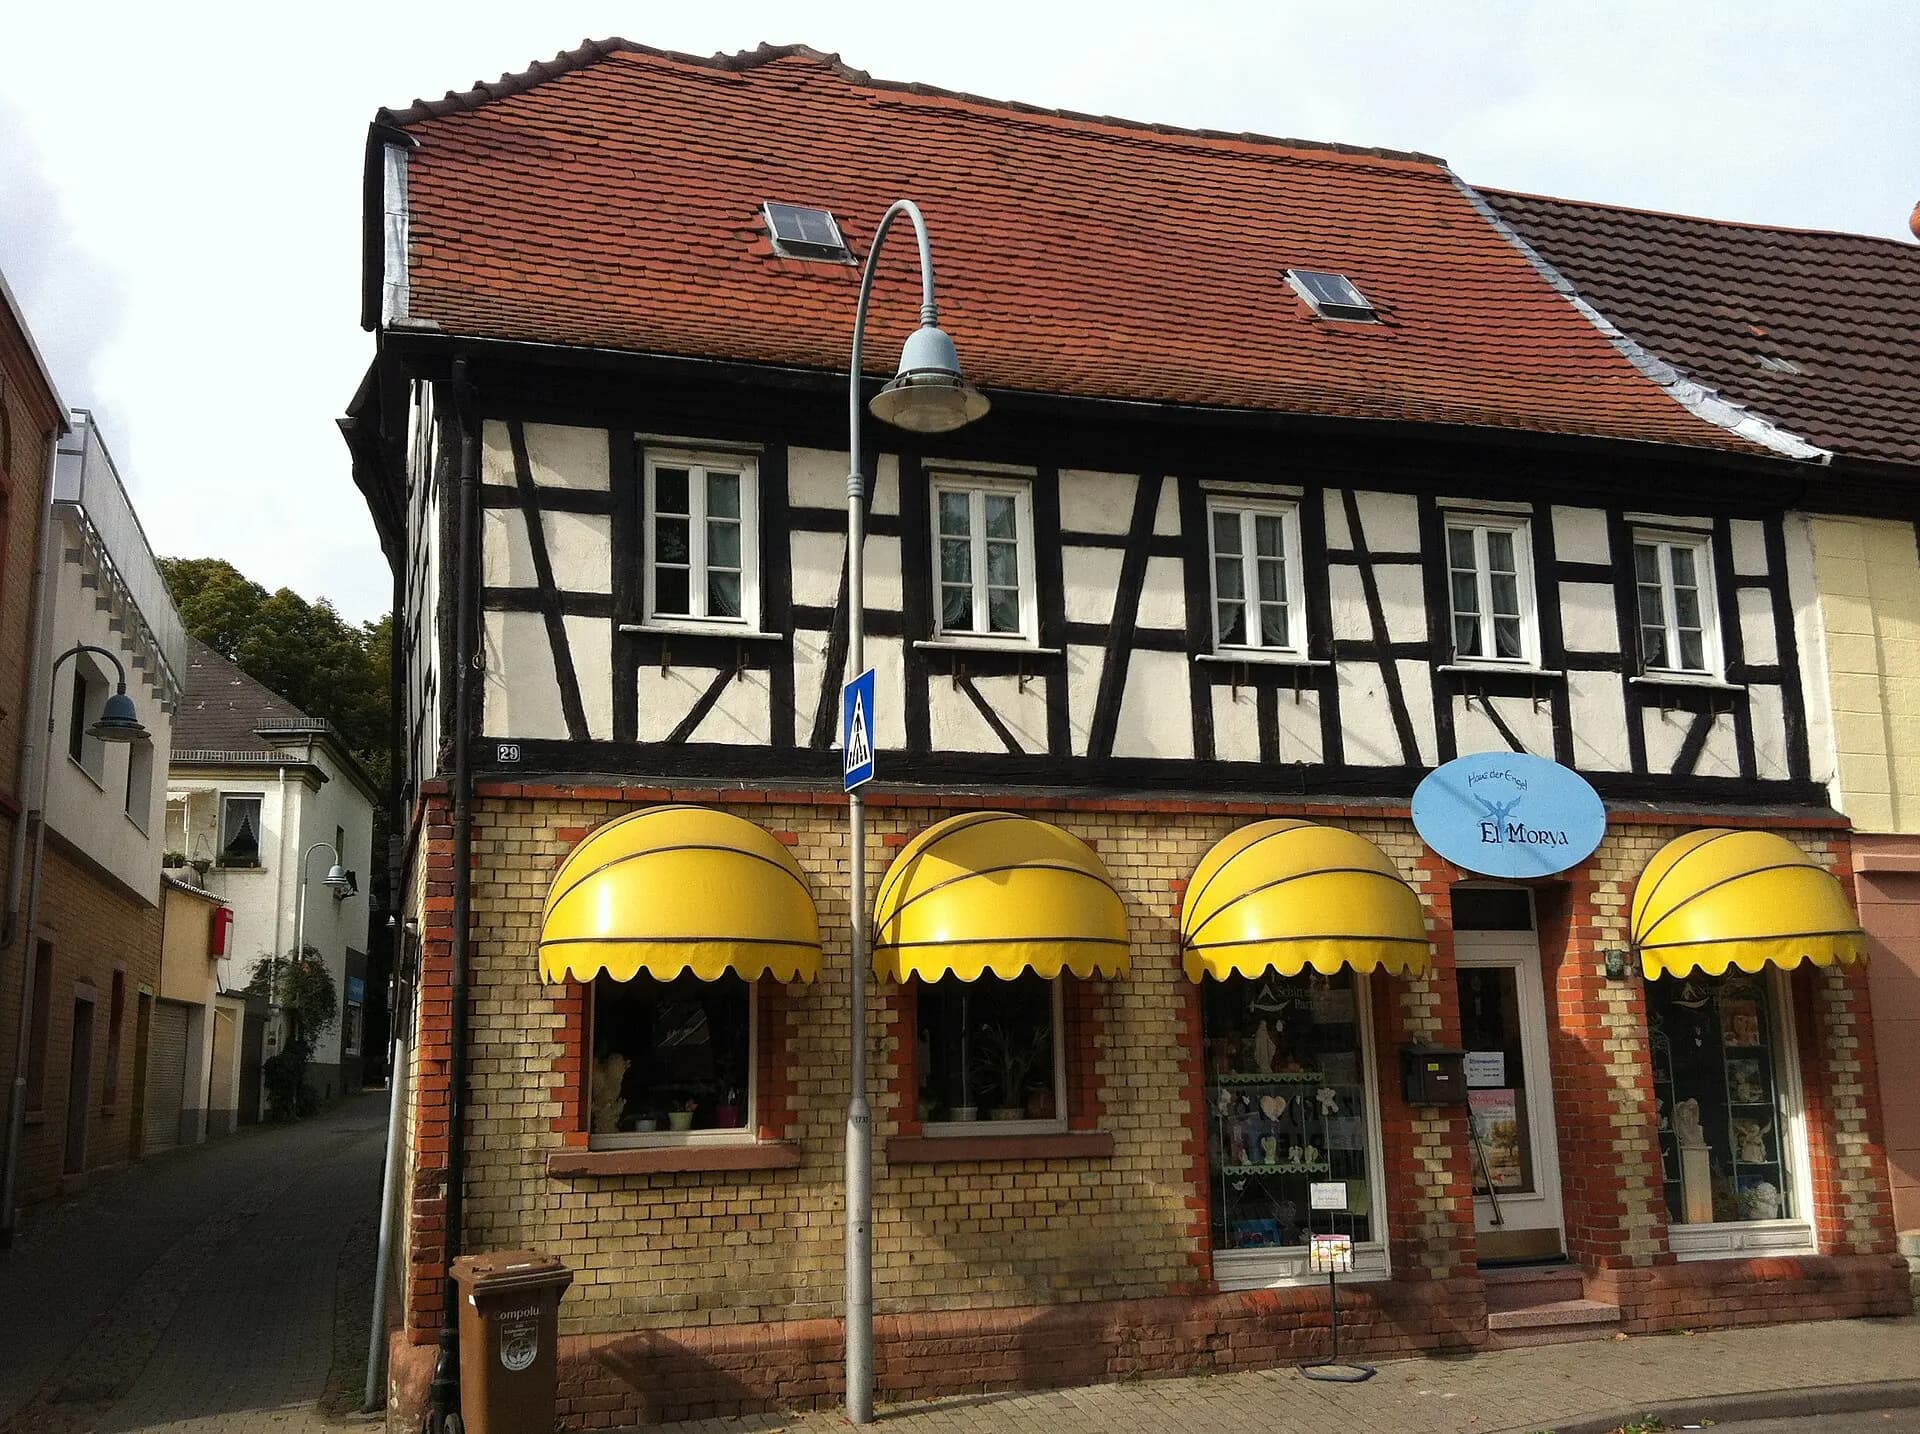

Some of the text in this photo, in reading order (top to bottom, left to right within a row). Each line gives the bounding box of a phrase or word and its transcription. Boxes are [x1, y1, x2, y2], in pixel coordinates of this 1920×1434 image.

[500, 746, 518, 760] 29
[1468, 772, 1488, 788] Haus
[1489, 769, 1504, 779] der
[1480, 822, 1502, 844] El
